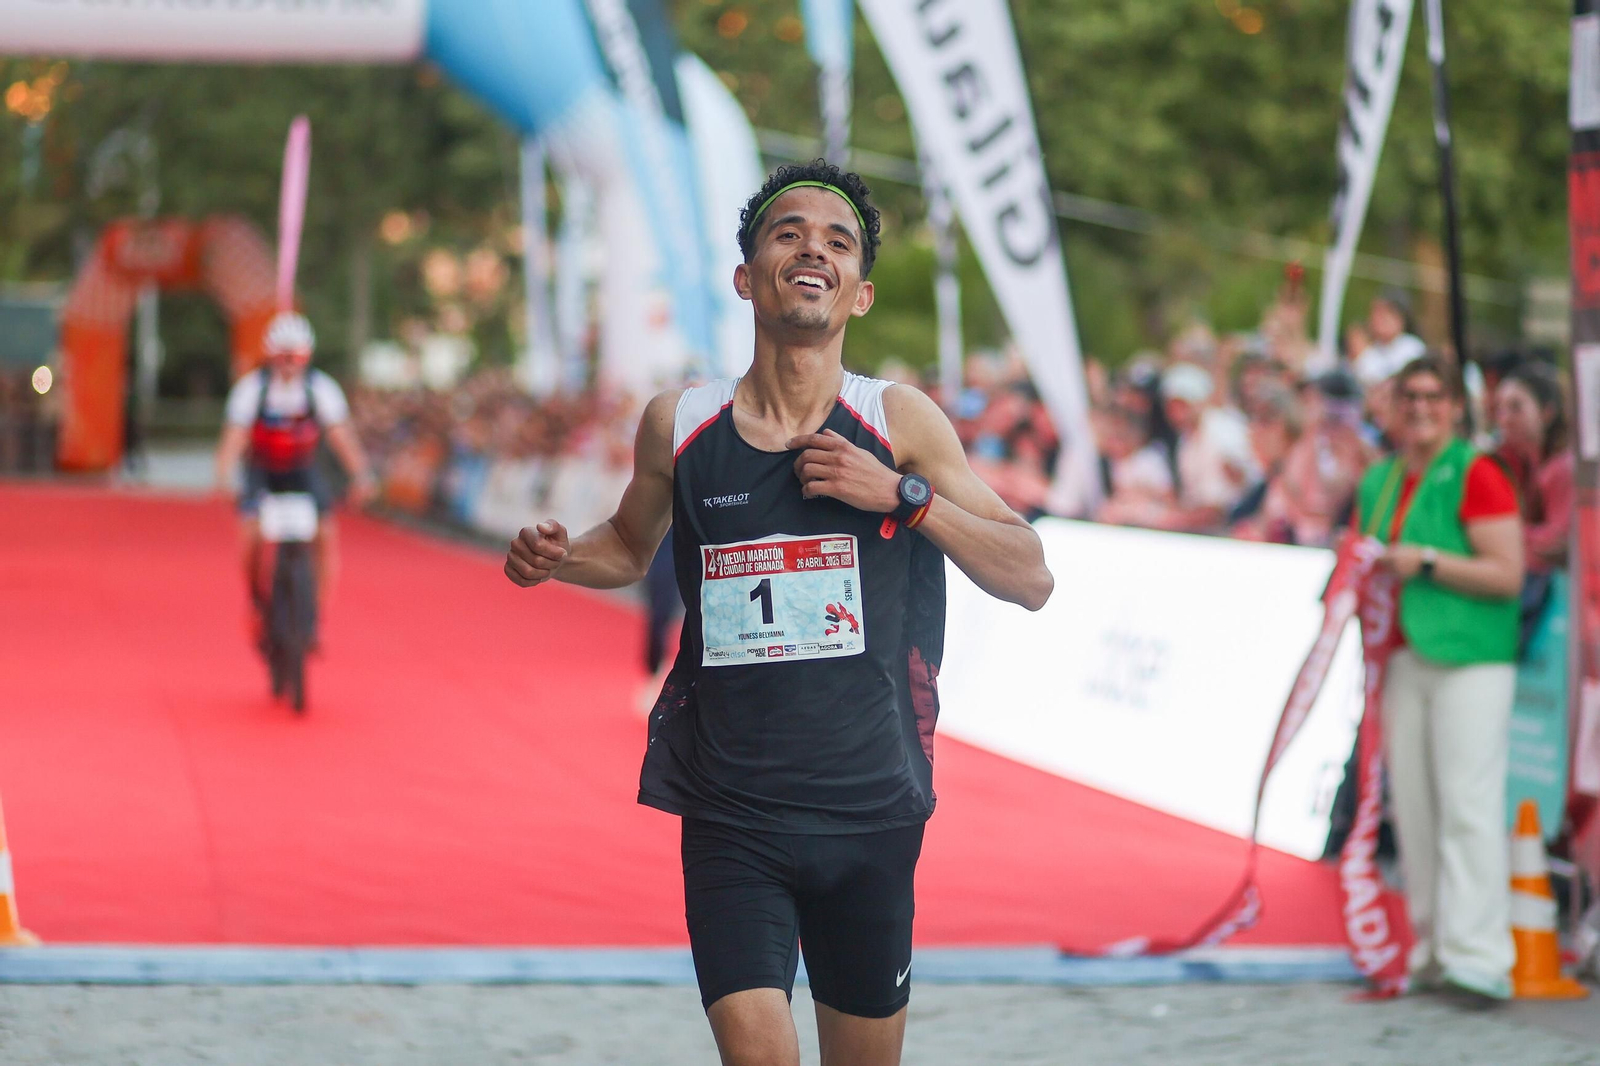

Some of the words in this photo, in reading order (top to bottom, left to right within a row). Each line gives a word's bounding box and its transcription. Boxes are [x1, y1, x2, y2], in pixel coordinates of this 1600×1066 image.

[713, 492, 750, 505] TAKELOT
[722, 549, 747, 566] MEDIA
[746, 545, 784, 563] MARATÓN
[796, 558, 805, 569] 26
[805, 556, 825, 568] ABRIL
[825, 554, 840, 567] 2025
[723, 563, 745, 576] CIUDAD
[745, 562, 754, 573] DE
[754, 559, 785, 573] GRANADA
[843, 579, 853, 601] SENIOR
[749, 578, 774, 625] 1
[737, 632, 759, 641] YOUNESS
[758, 630, 785, 639] BELYAMNA
